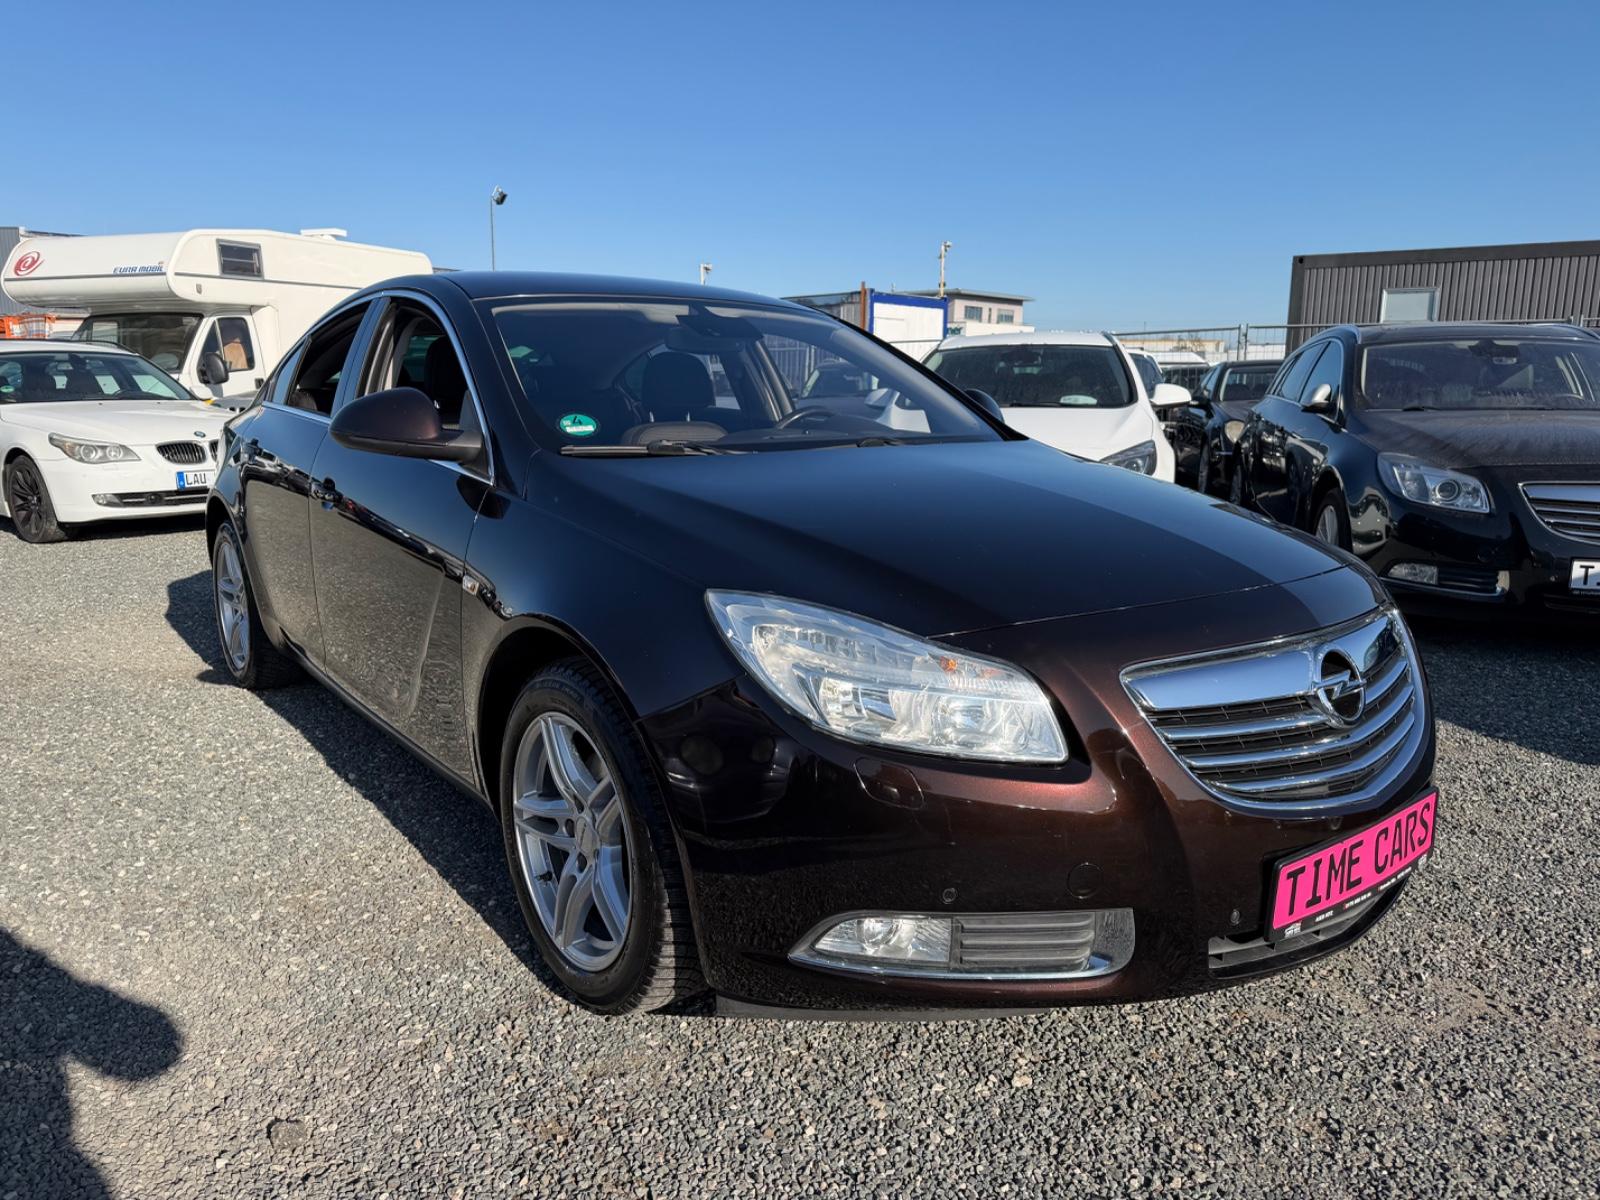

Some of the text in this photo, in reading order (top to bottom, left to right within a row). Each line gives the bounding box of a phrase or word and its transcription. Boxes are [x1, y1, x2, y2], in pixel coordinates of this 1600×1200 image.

[186, 472, 207, 486] LAU
[1286, 802, 1431, 917] TIME CARS
